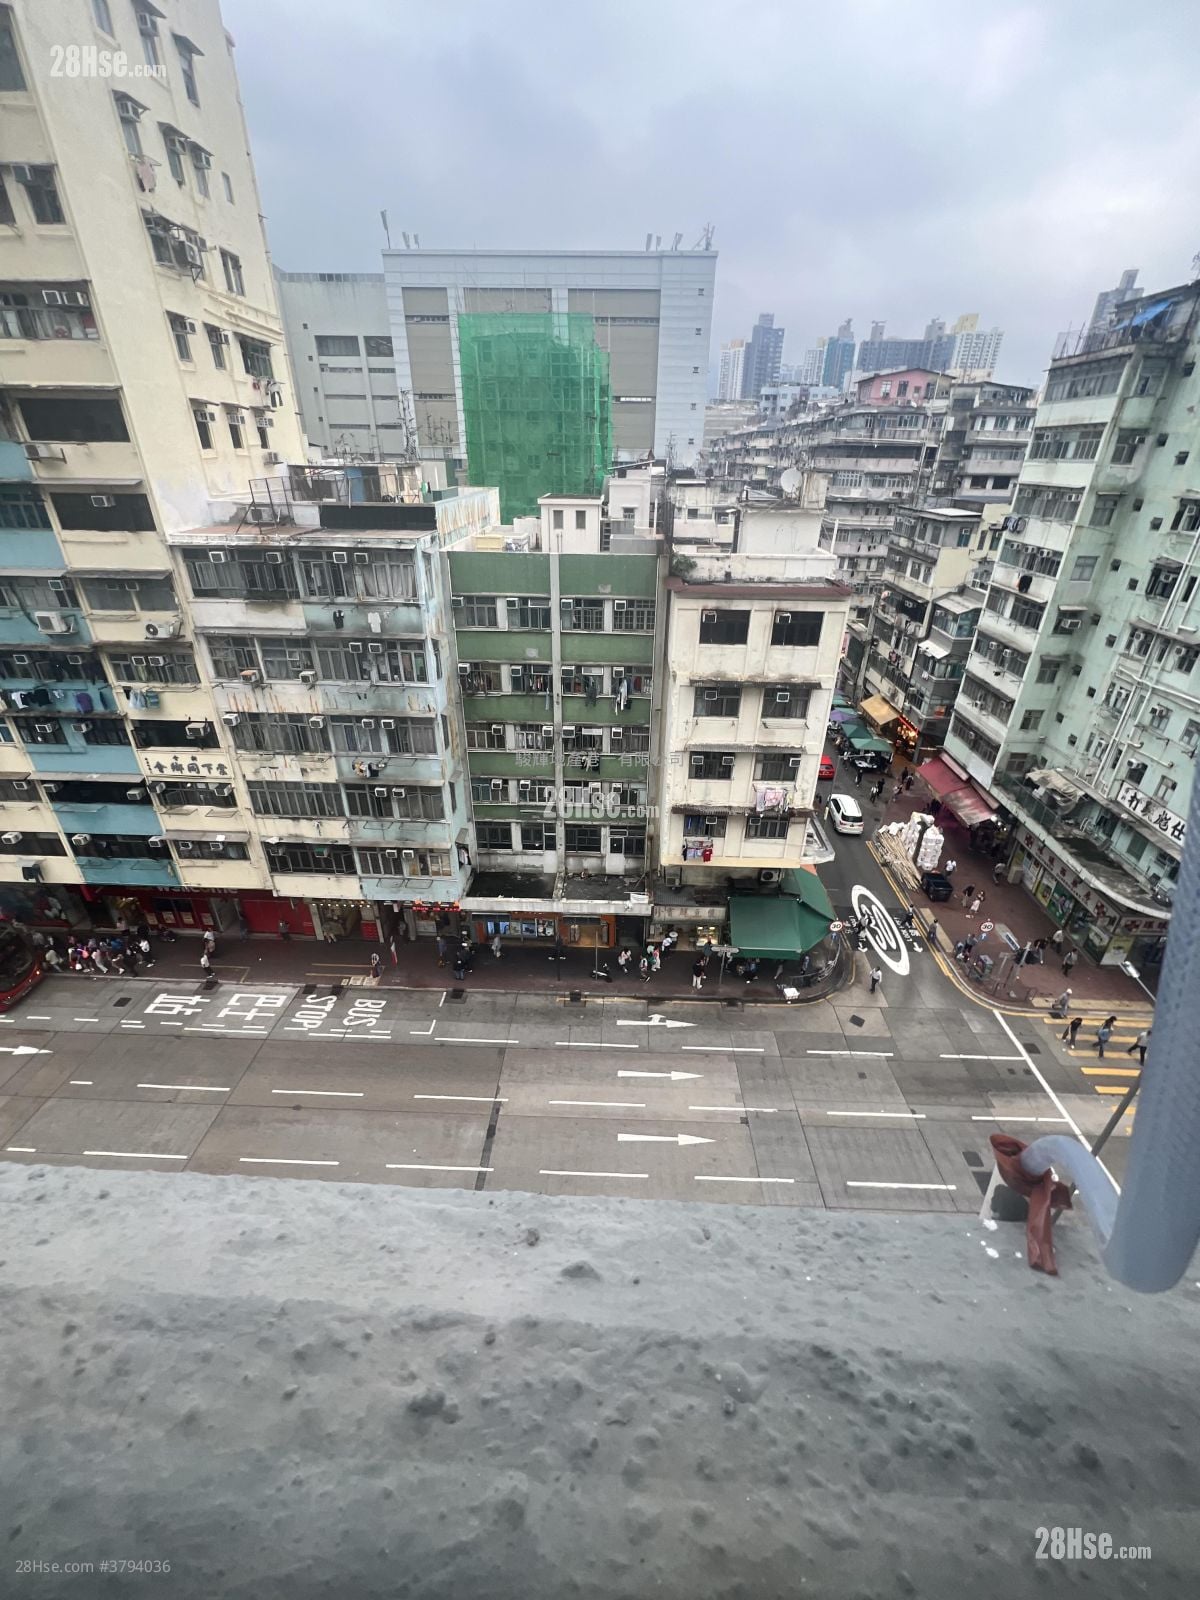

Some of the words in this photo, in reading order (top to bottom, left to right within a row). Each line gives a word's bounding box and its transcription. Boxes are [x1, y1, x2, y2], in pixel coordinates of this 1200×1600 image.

[144, 993, 211, 1016] 站
[216, 993, 289, 1021] 巴士
[290, 994, 338, 1029] STOP
[342, 998, 387, 1027] BUS
